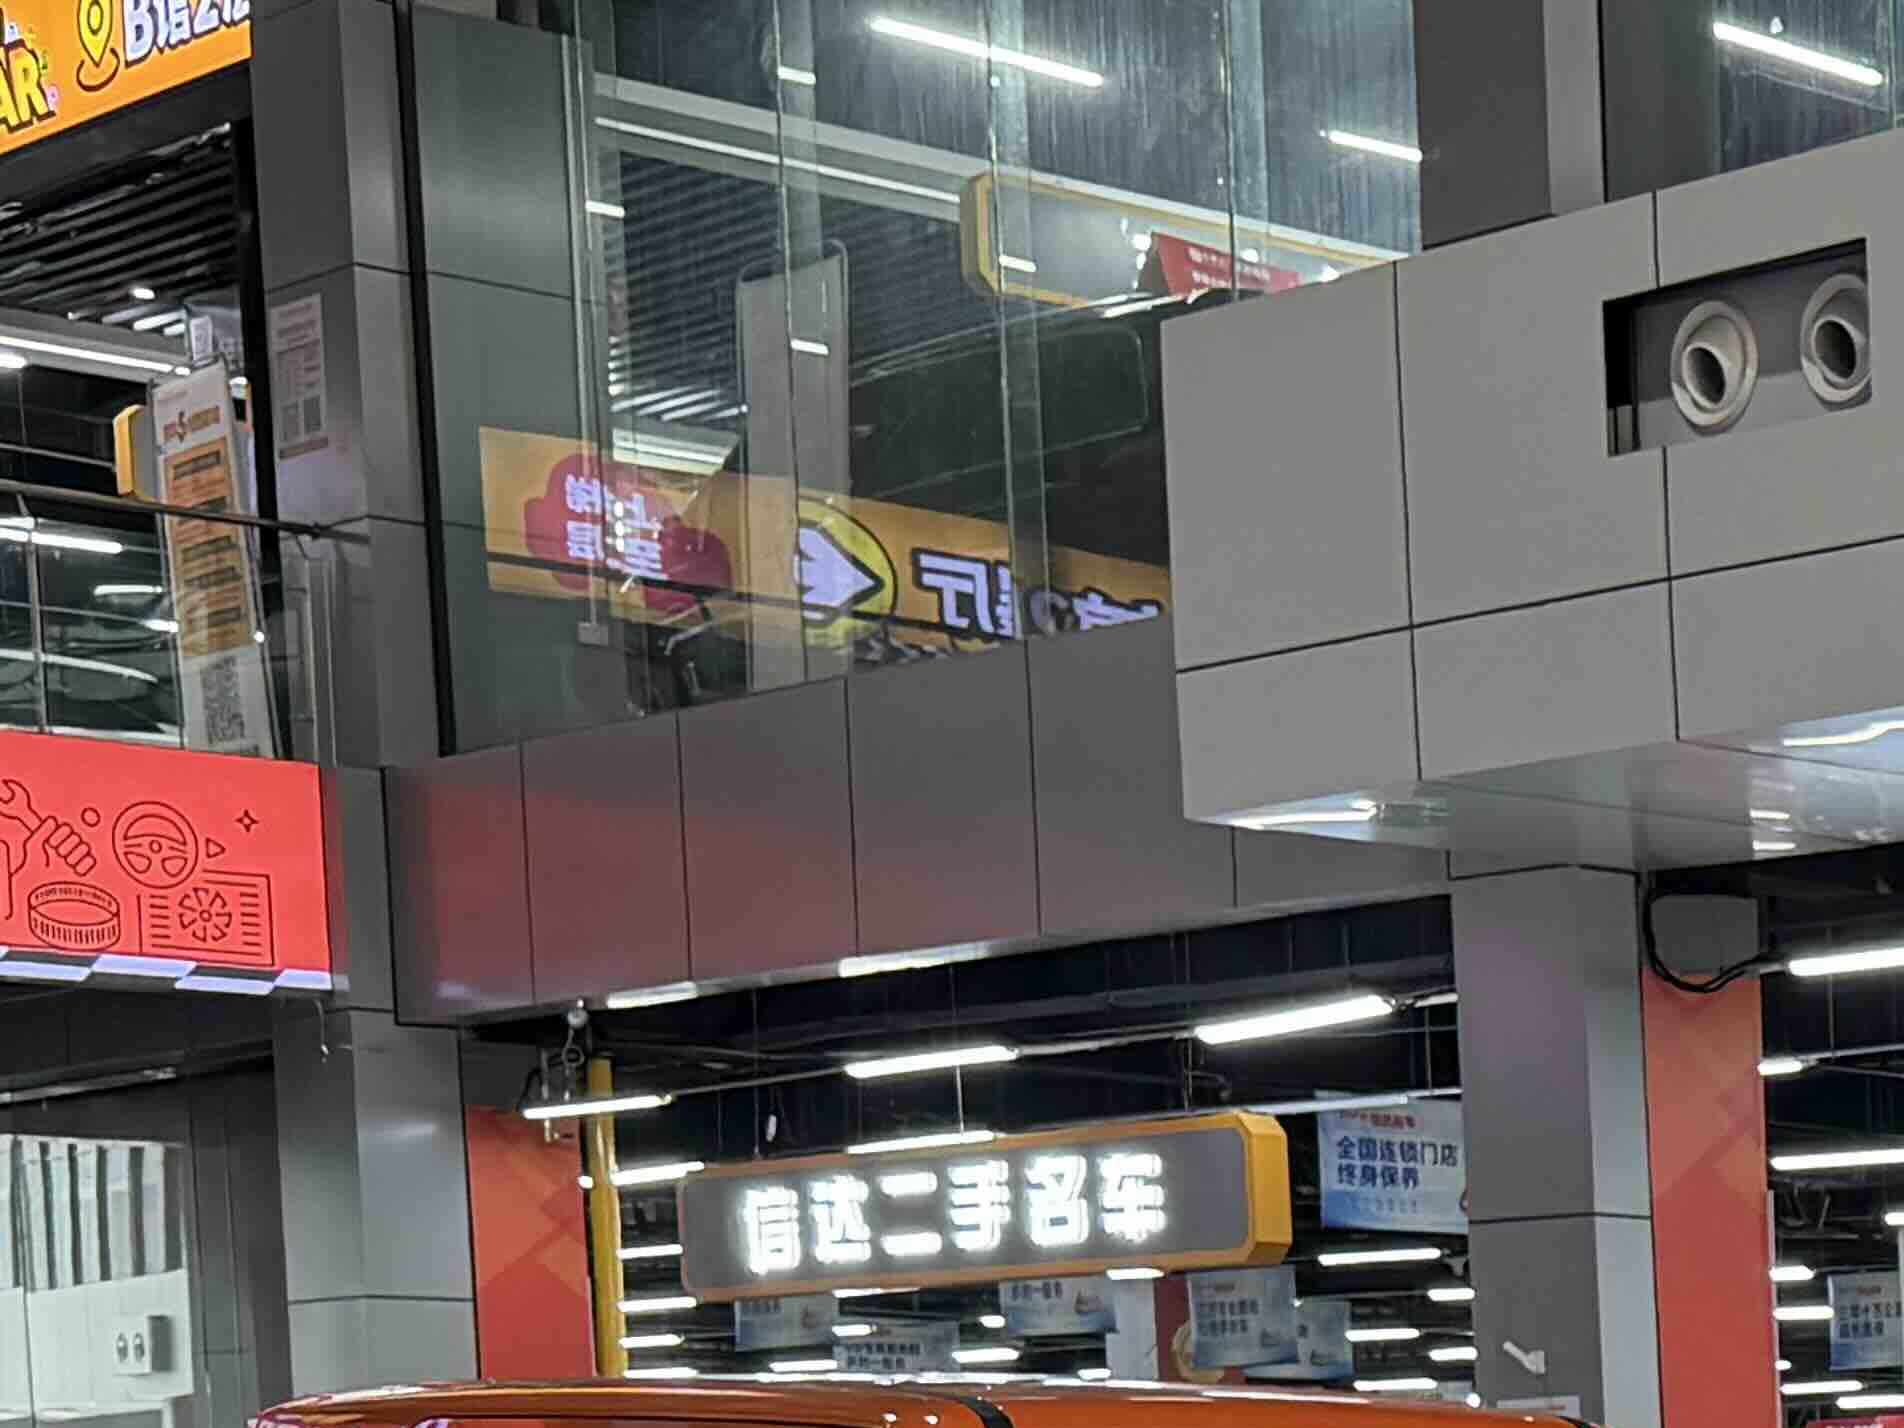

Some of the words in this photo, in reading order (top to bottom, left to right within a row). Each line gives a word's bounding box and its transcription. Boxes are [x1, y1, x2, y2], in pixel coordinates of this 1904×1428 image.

[1336, 1135, 1459, 1167] 全国连锁门店
[1337, 1163, 1420, 1189] 终身保养
[740, 1150, 1169, 1275] 信达二手名车
